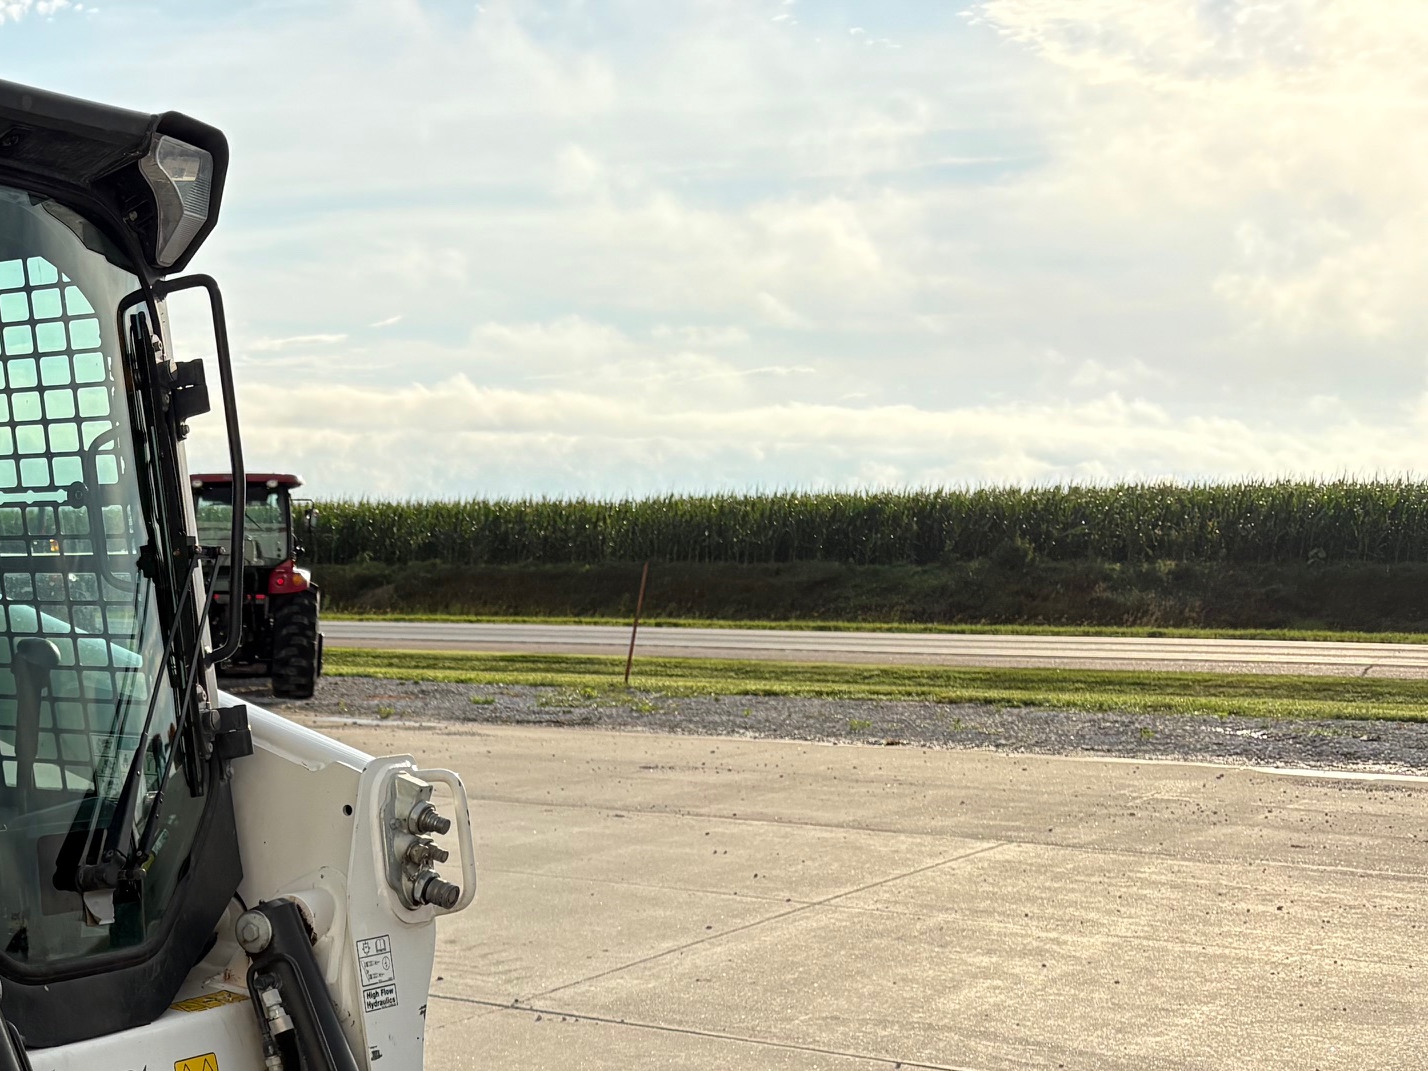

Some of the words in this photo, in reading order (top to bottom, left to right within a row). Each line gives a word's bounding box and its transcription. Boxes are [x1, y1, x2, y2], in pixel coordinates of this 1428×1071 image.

[366, 990, 380, 1000] High
[380, 988, 394, 997] Flow
[366, 997, 396, 1010] Hydraulics
